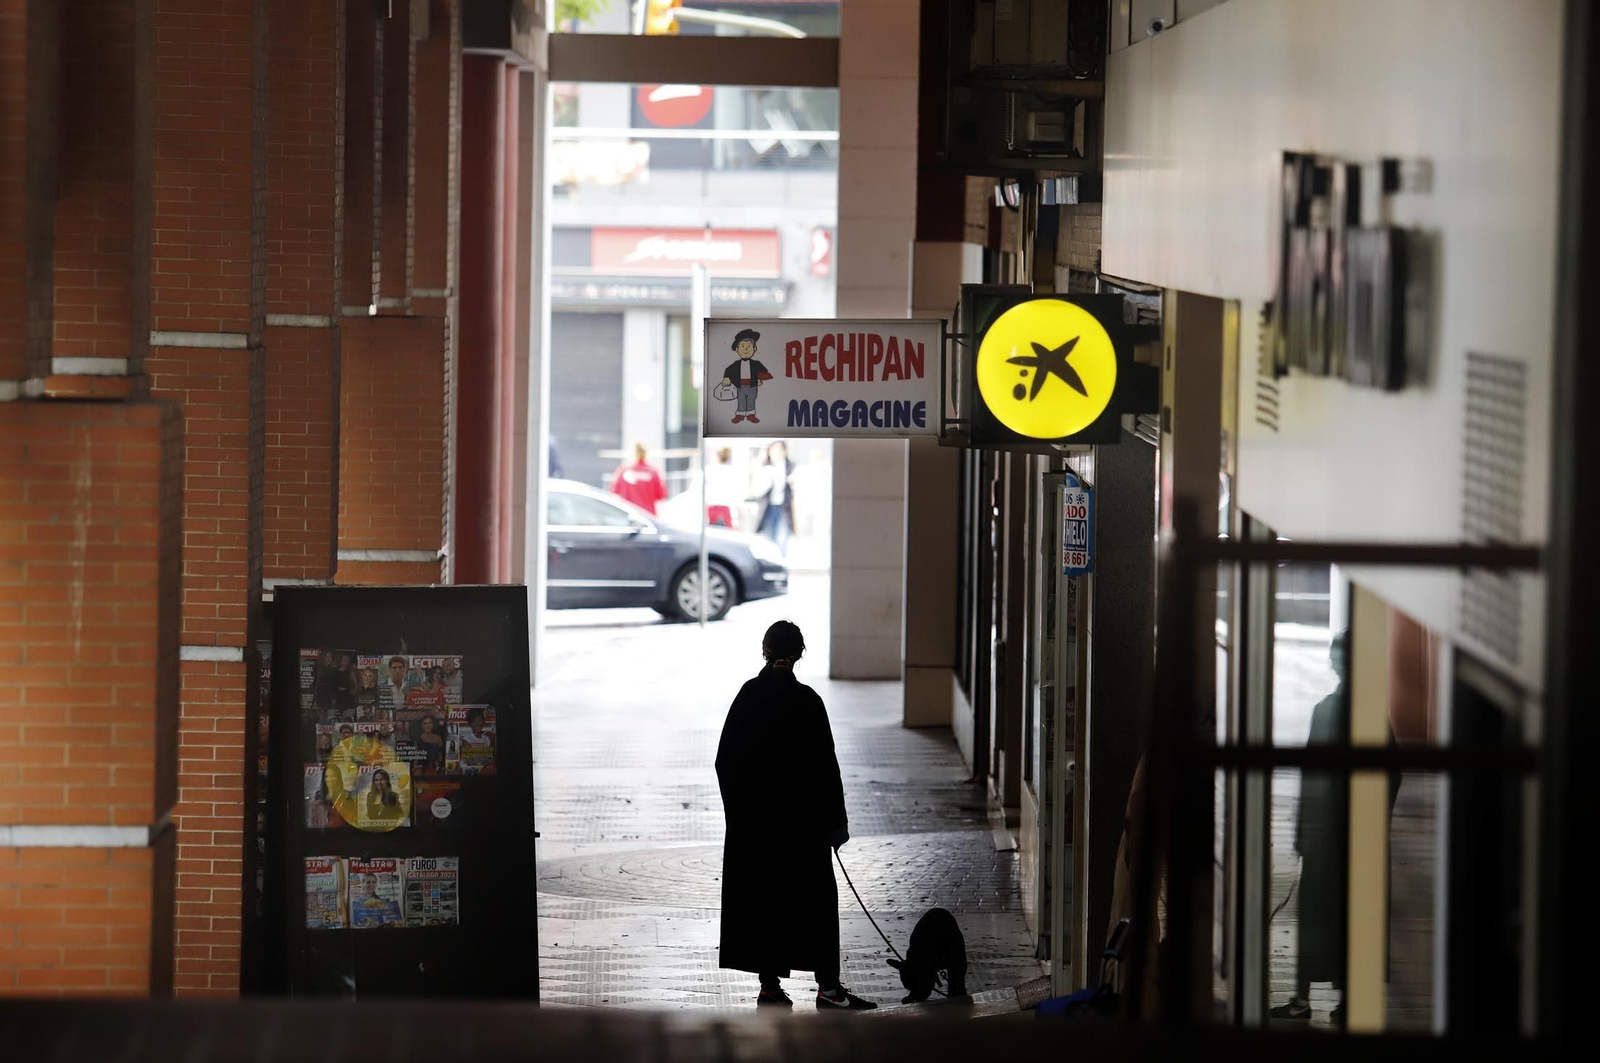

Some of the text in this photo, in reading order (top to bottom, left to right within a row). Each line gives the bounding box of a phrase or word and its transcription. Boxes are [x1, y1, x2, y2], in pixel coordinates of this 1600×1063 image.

[785, 333, 925, 382] RECHIPAN
[787, 399, 926, 428] MAGACINE
[1072, 553, 1086, 566] 661
[448, 708, 466, 719] más
[411, 859, 437, 871] FURGO
